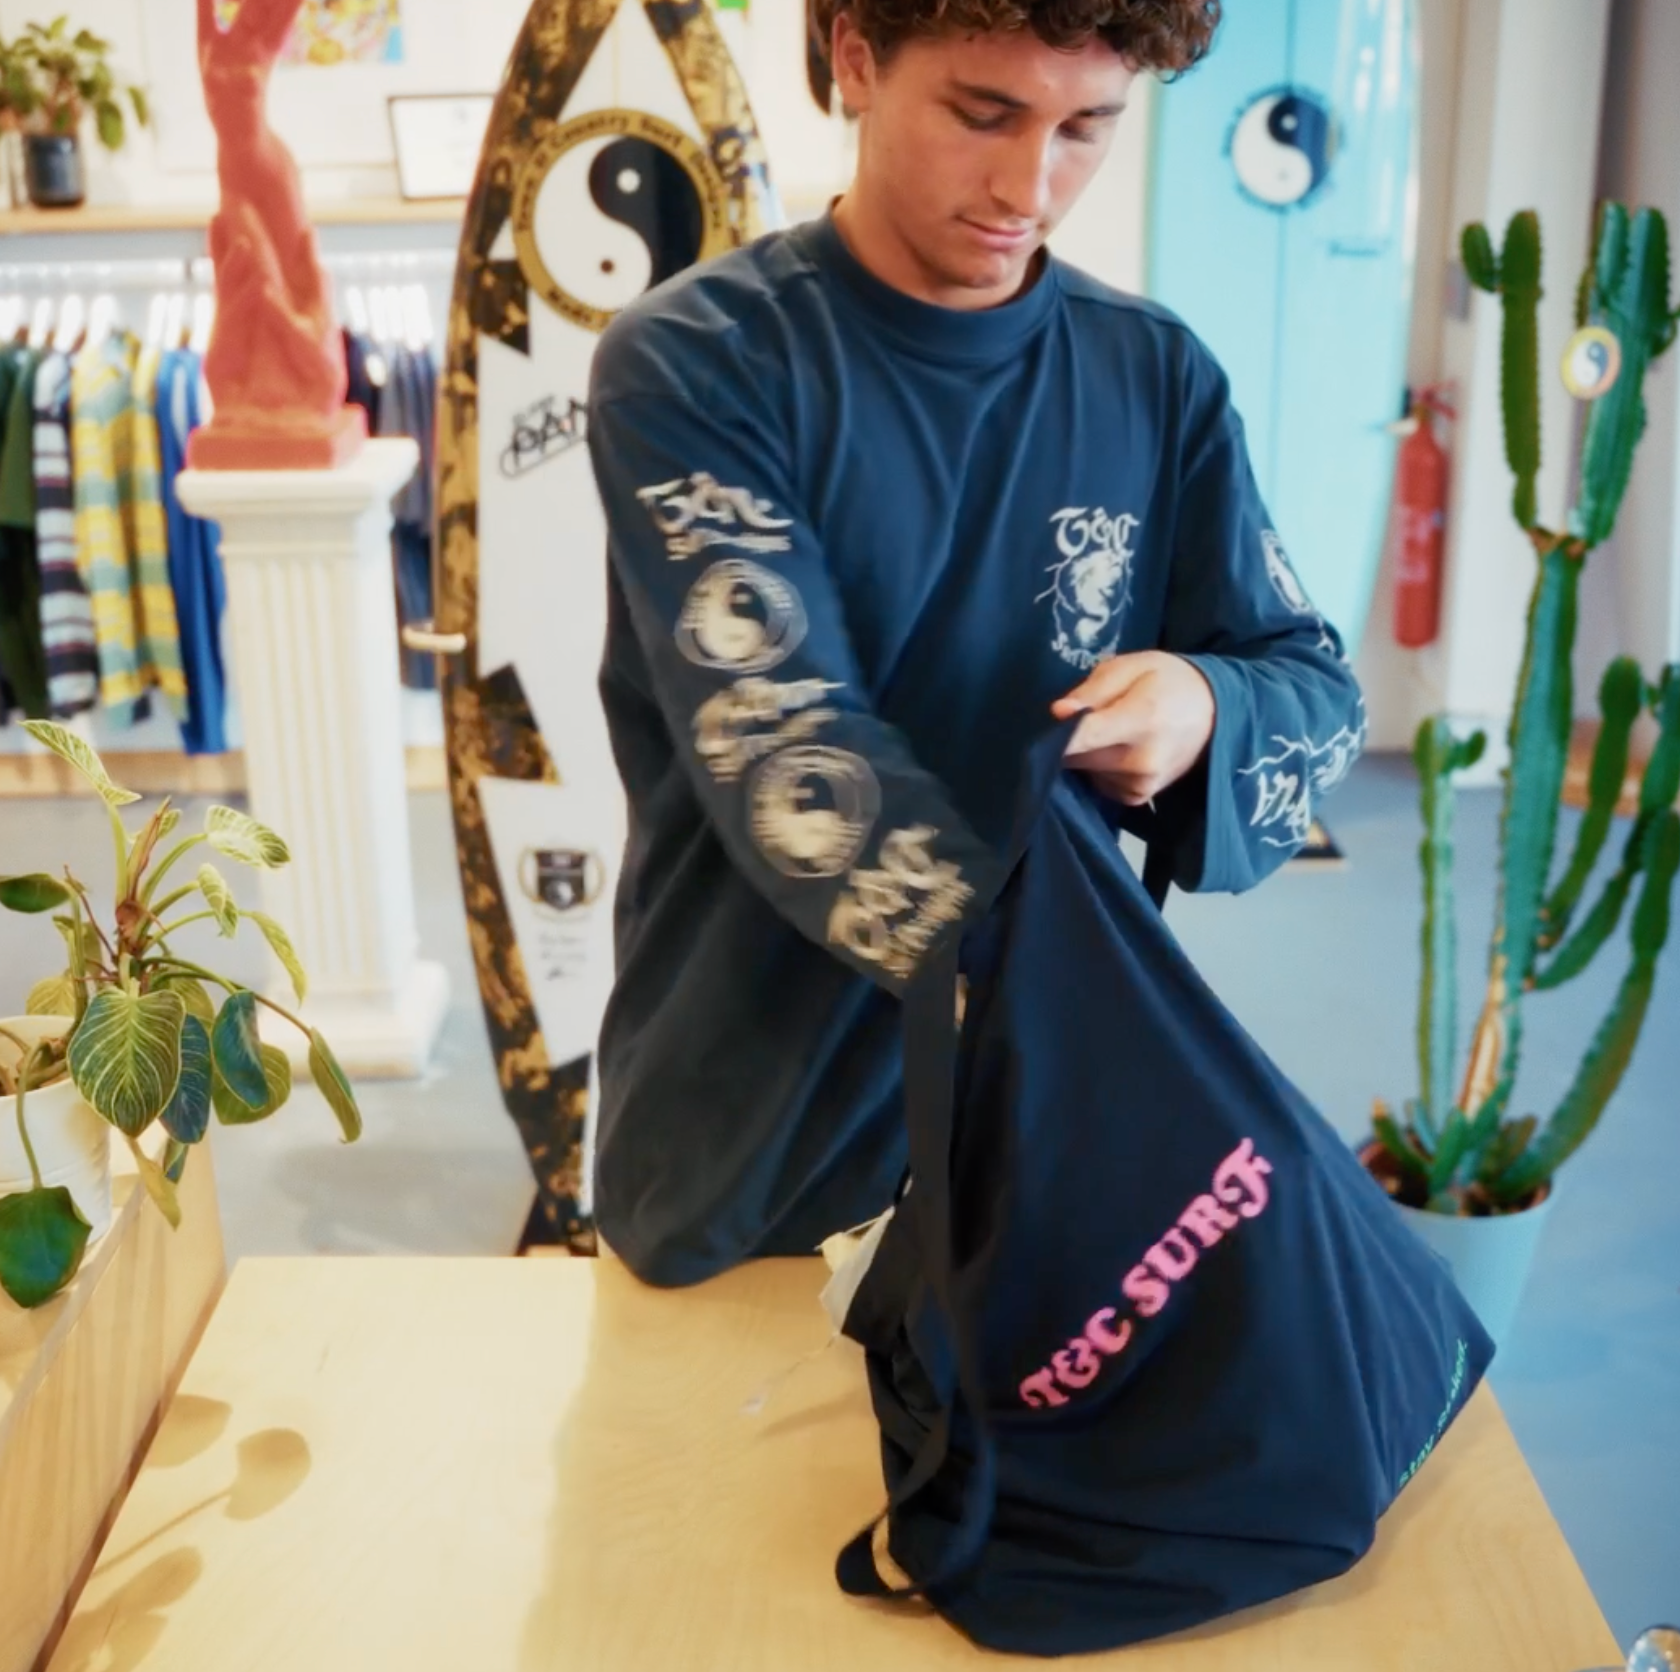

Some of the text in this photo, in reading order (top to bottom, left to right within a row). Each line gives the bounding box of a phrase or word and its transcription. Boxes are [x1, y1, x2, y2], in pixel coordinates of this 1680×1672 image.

[547, 114, 630, 150] Country
[640, 116, 685, 150] Surf
[1018, 1136, 1274, 1409] T&C SURF
